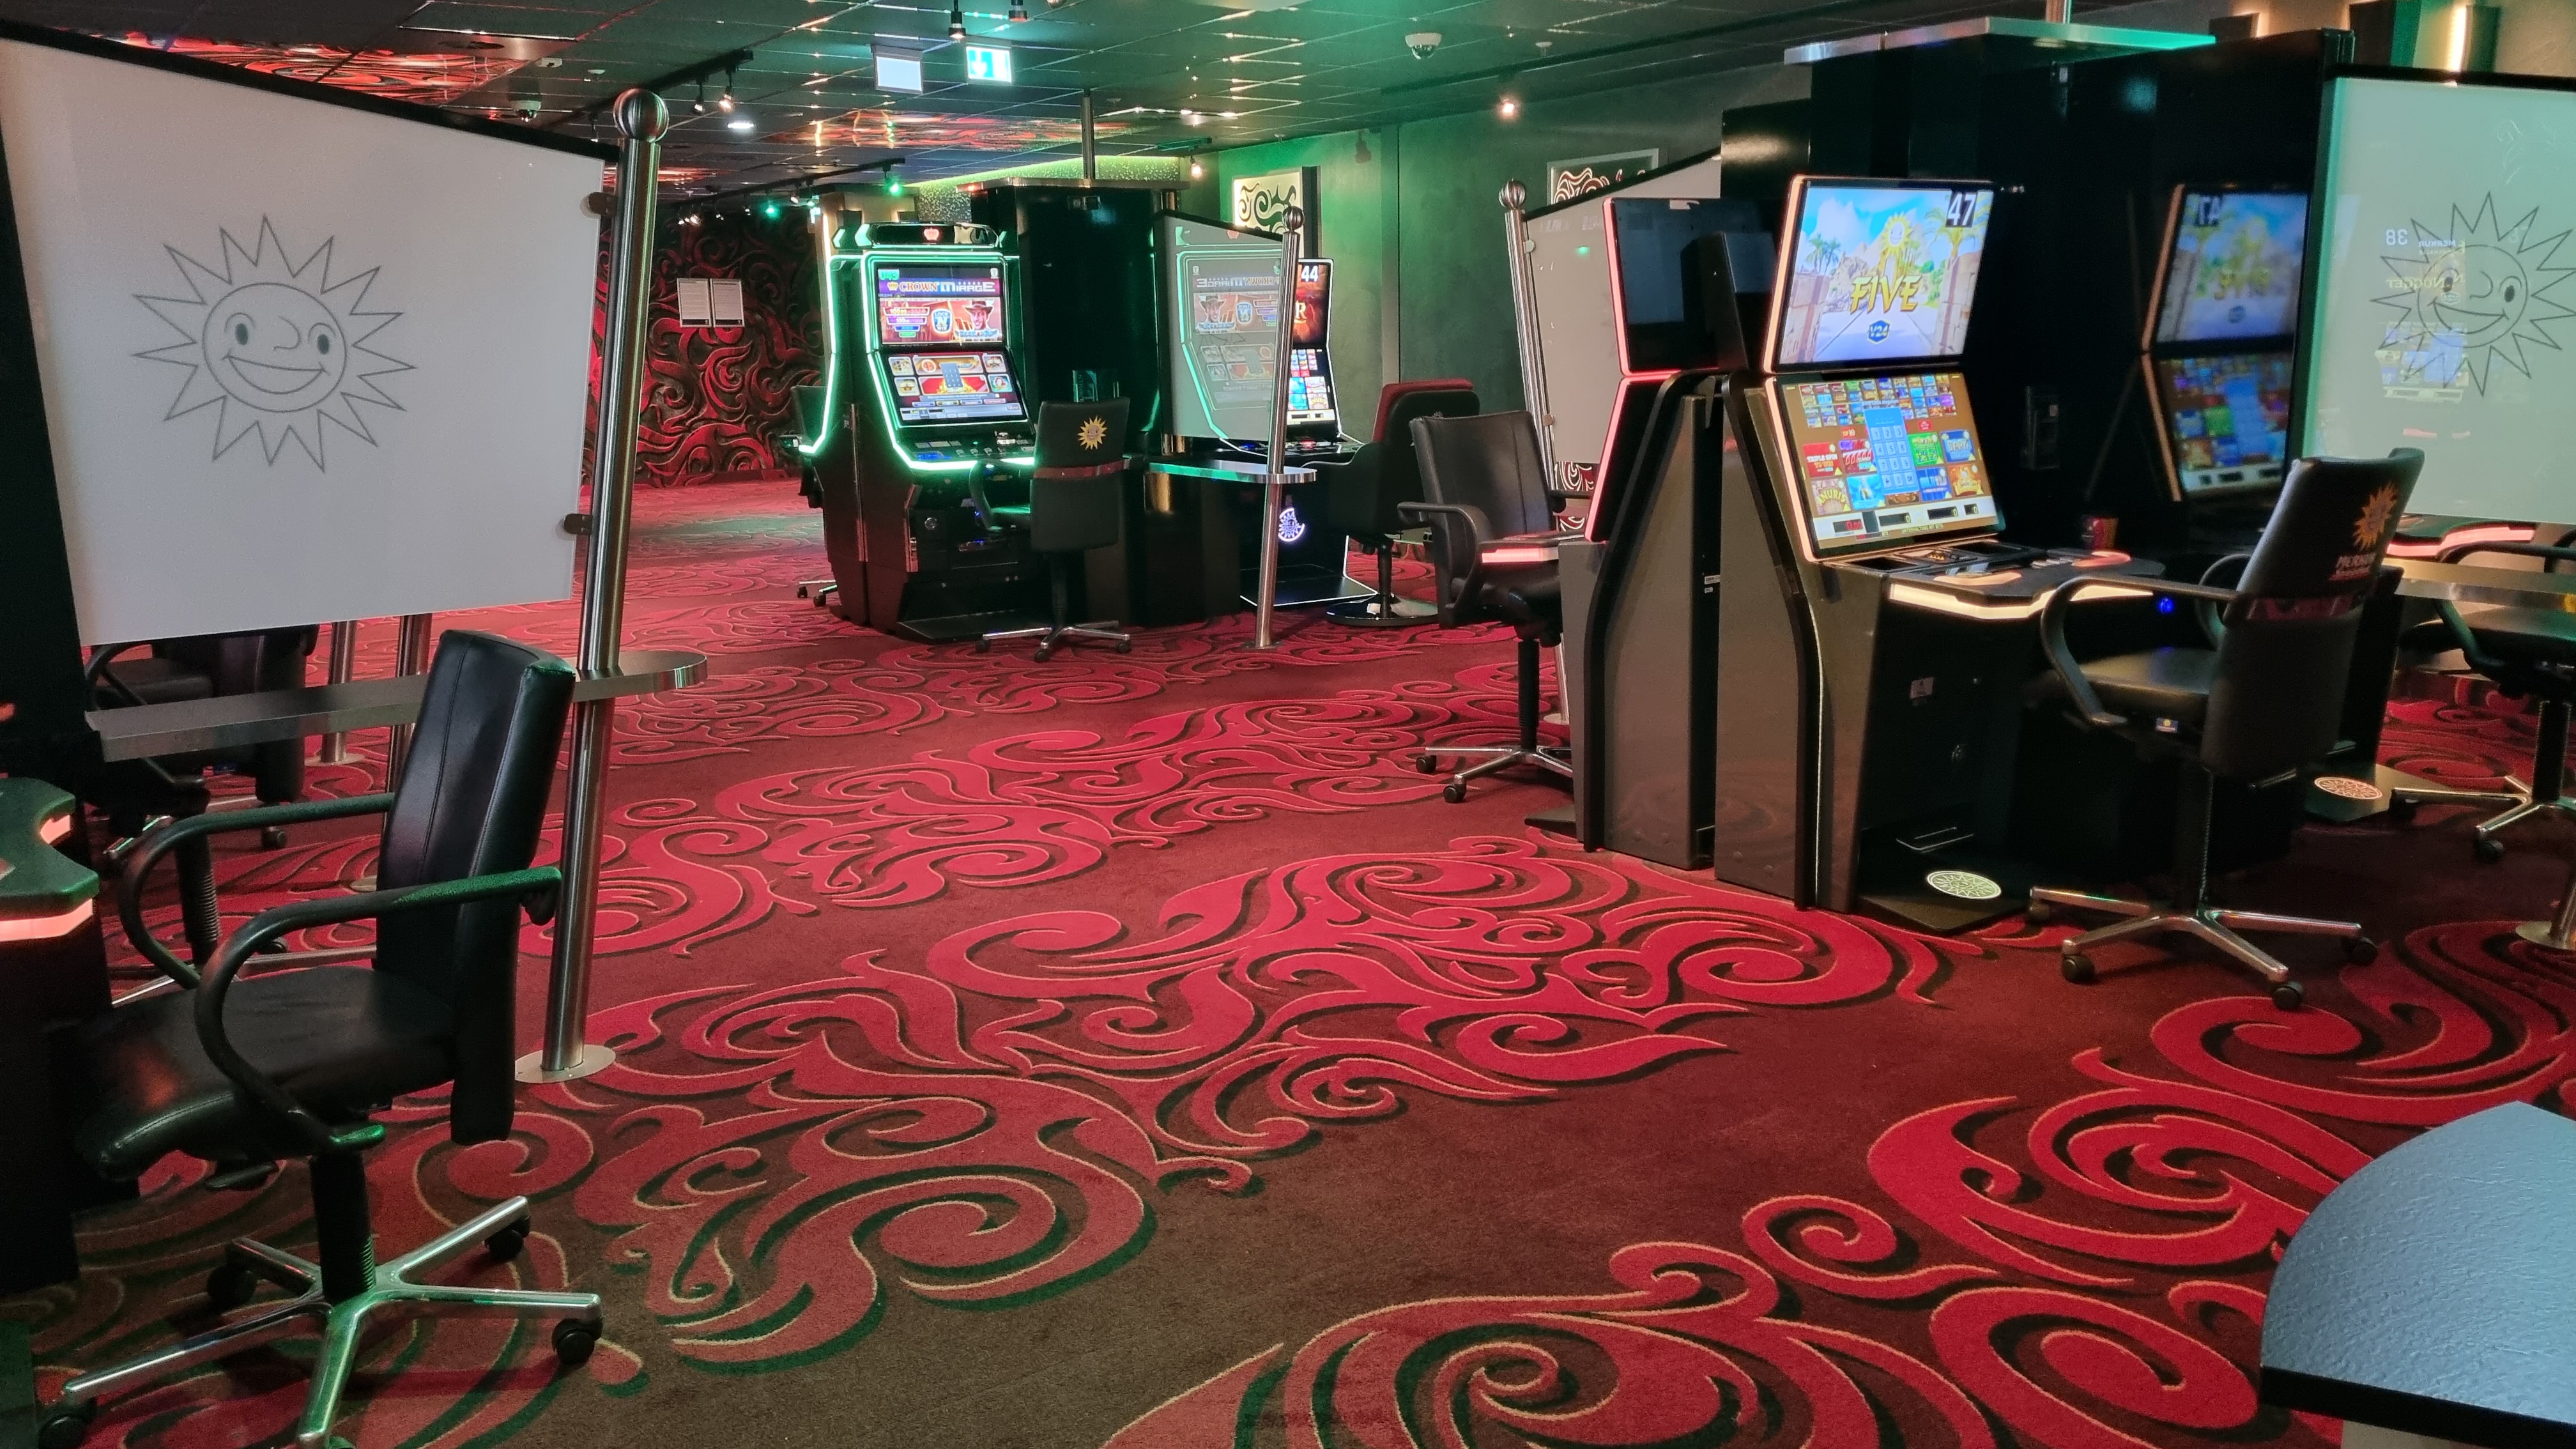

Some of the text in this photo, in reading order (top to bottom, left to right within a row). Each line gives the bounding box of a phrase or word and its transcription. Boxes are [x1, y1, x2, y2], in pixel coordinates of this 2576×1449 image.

[1948, 193, 1976, 226] 47
[1301, 265, 1319, 282] 44
[899, 281, 995, 292] CROWN MIRAGE
[1850, 274, 1922, 315] FIVE
[1817, 489, 1847, 506] ANURIS
